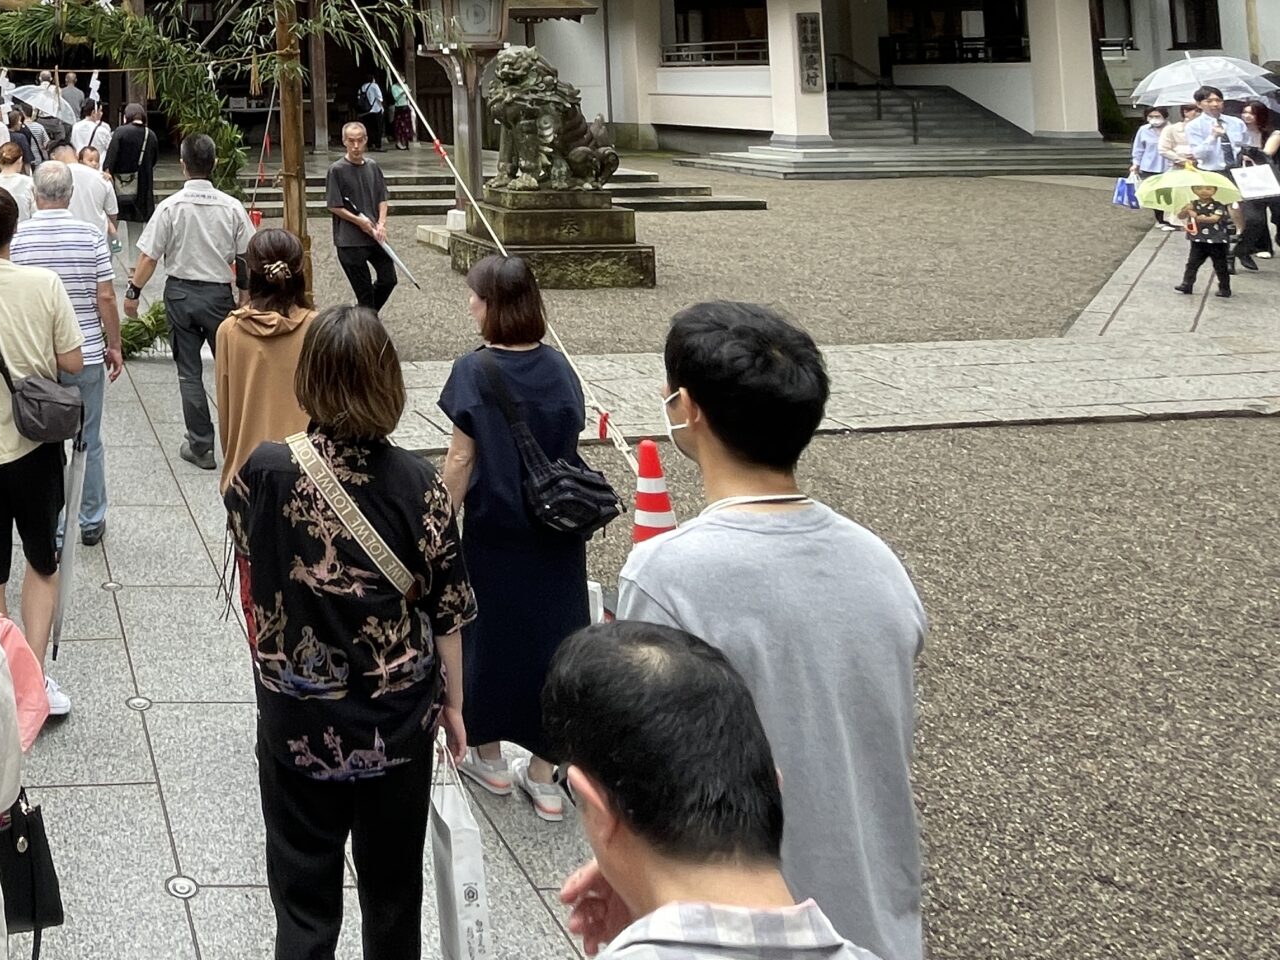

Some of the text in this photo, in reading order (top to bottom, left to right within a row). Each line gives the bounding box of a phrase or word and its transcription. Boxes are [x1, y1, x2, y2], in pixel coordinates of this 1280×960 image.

[806, 54, 820, 87] 受付
[313, 469, 352, 515] LOEWE
[350, 515, 388, 562] LOEWE
